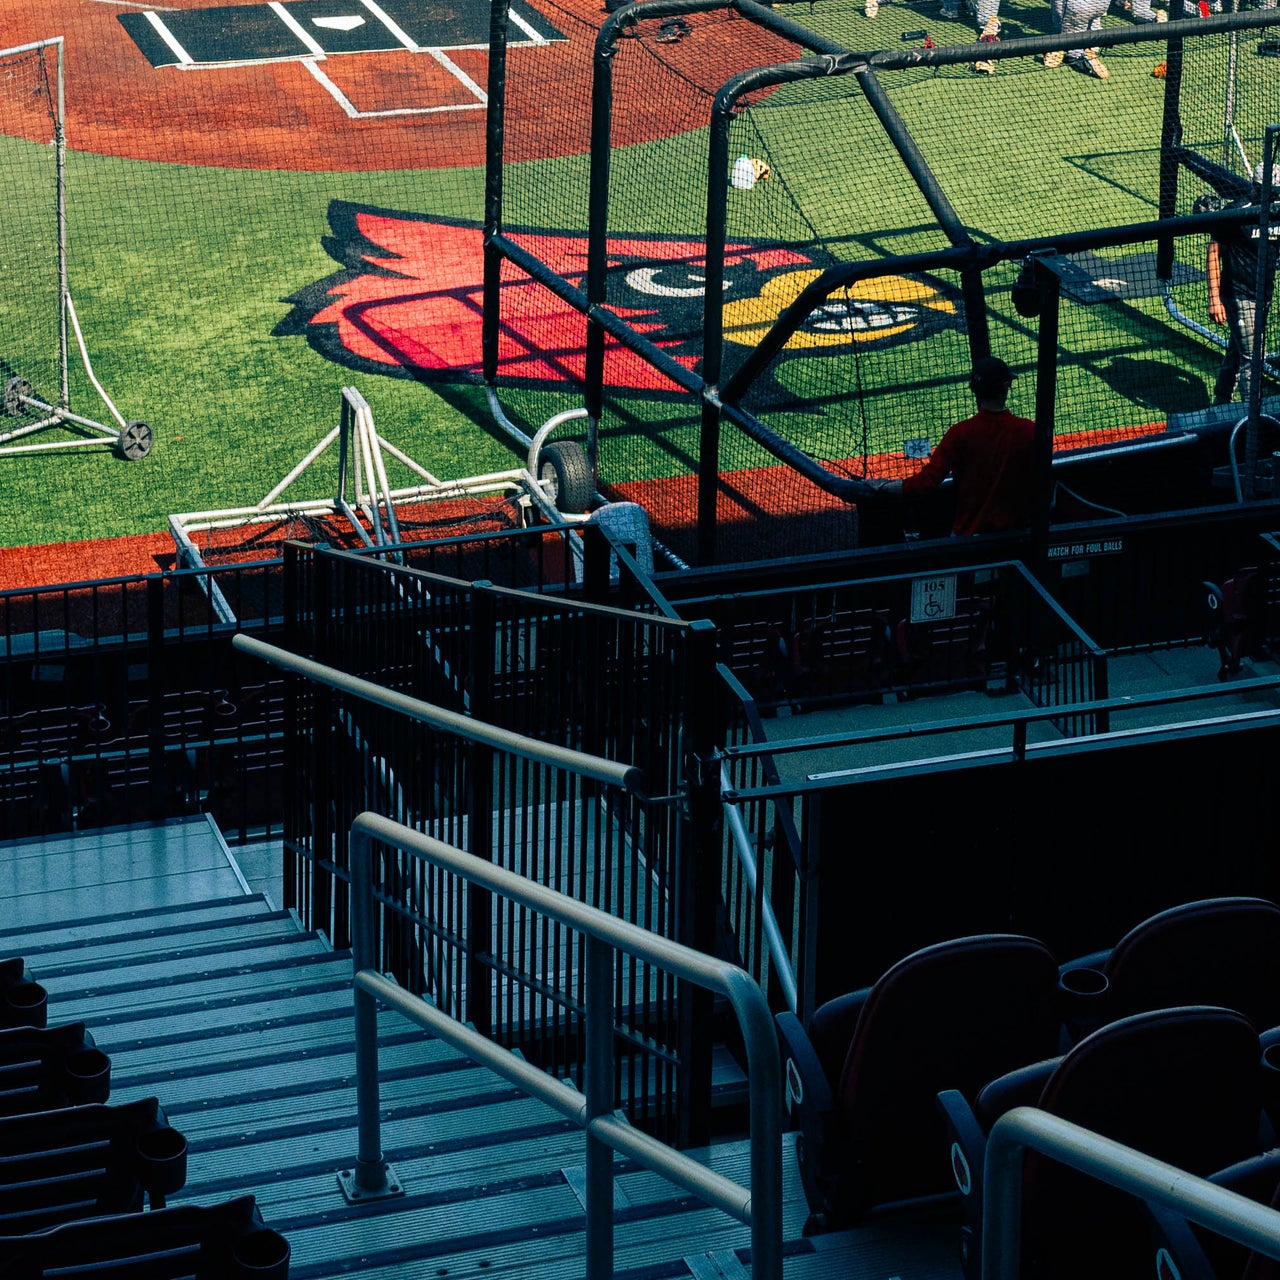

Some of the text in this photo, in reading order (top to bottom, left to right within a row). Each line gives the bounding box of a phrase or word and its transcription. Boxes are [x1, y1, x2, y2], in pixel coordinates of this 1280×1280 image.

[1047, 539, 1123, 558] WATCH FOR FOUL BALLS
[922, 581, 945, 593] 105
